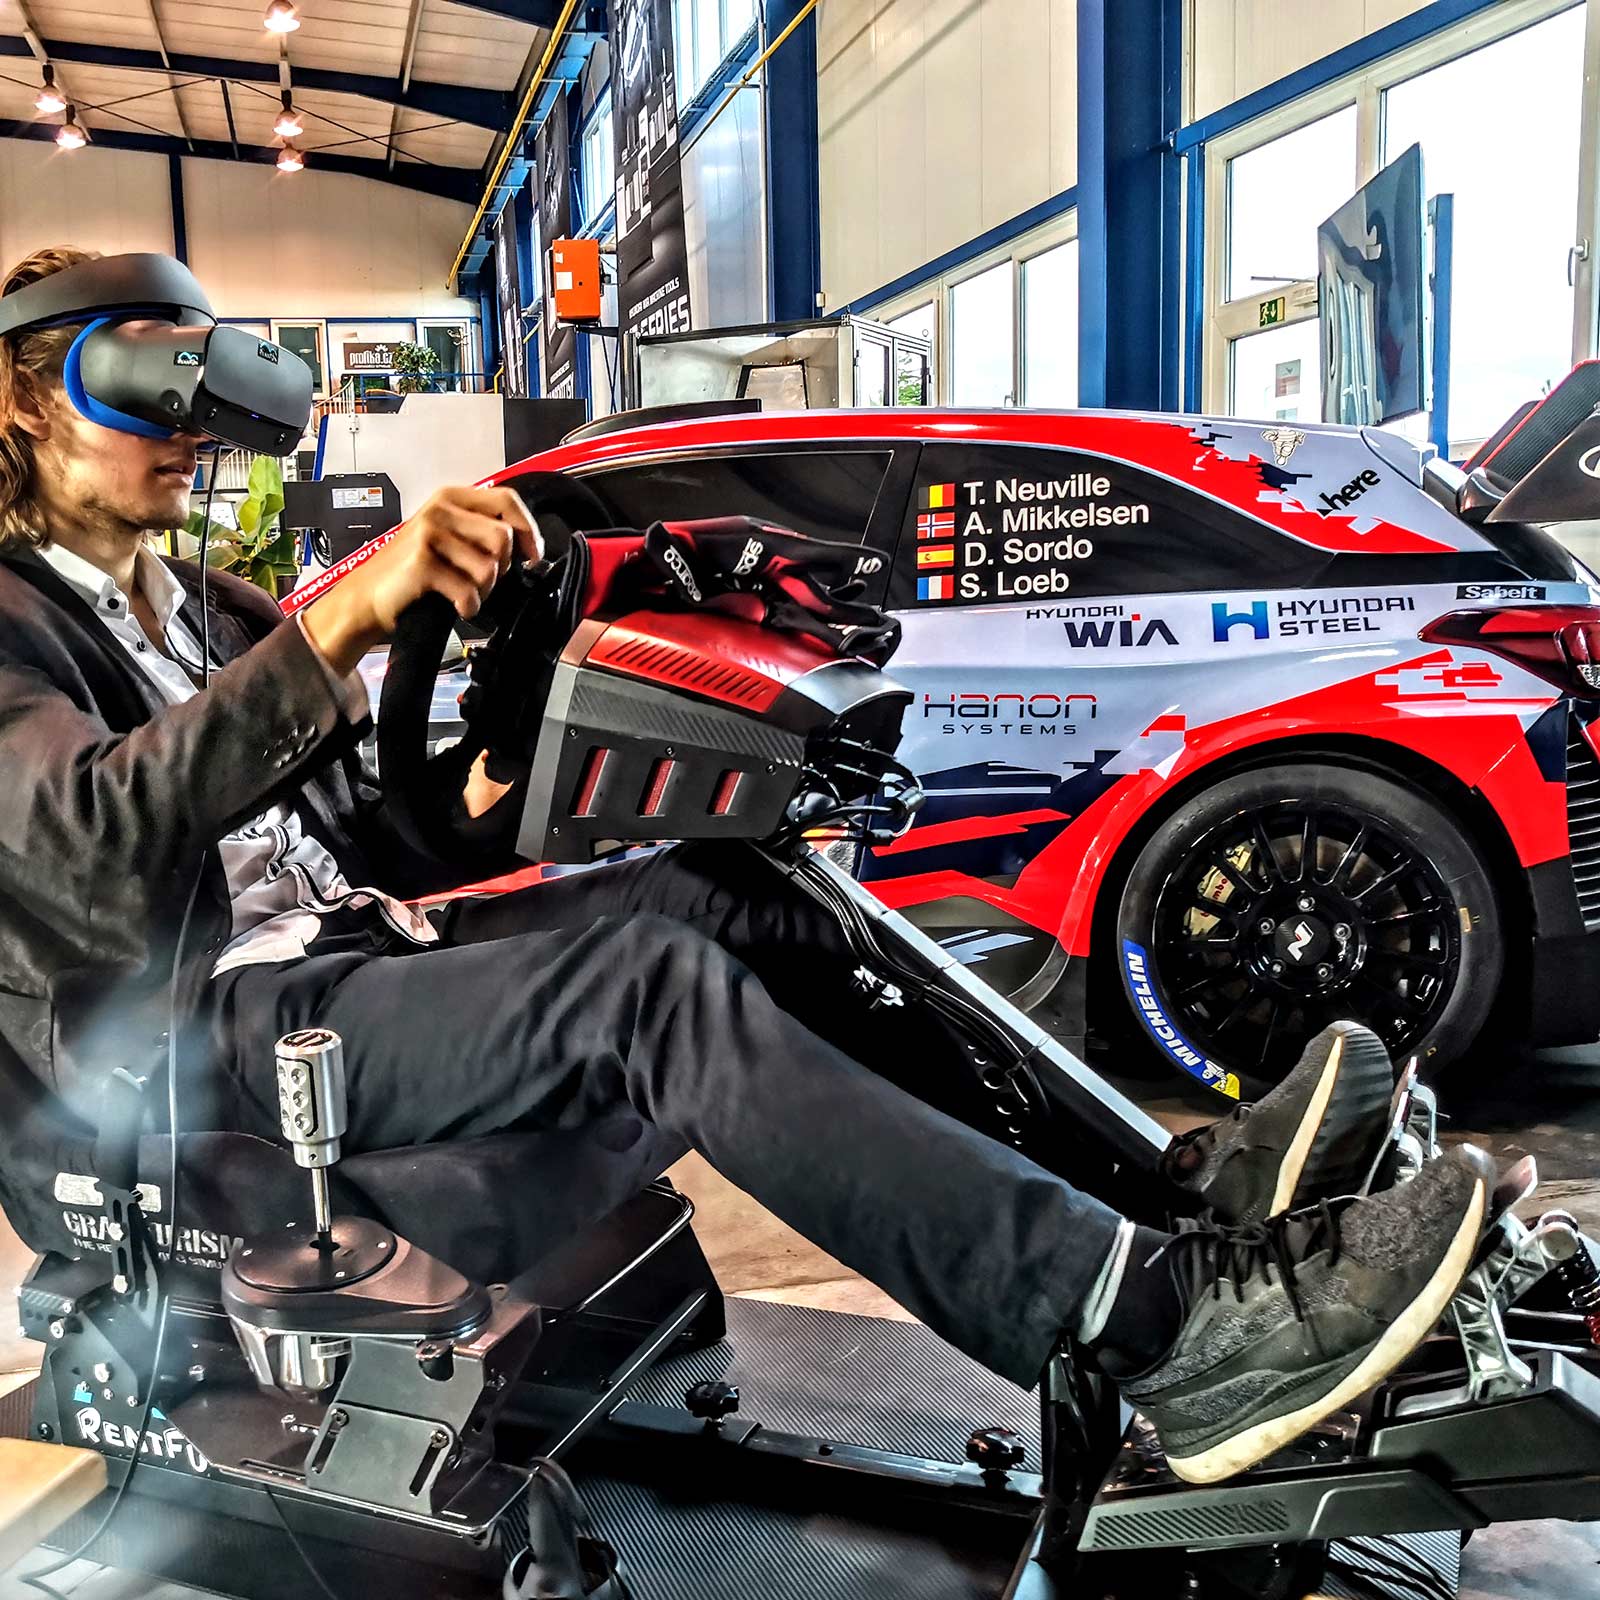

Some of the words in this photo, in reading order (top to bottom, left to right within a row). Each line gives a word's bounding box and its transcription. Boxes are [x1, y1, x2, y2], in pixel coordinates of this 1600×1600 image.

[963, 481, 986, 506] T.
[995, 473, 1111, 504] Neuville
[1319, 469, 1381, 511] here
[963, 511, 993, 537] A.
[1002, 502, 1150, 534] Mikkelsen
[964, 542, 994, 567] D.
[1003, 534, 1093, 564] Sordo
[291, 530, 399, 606] motorsport.h
[960, 573, 987, 599] S.
[997, 568, 1070, 597] Loeb
[1277, 597, 1415, 617] HYUNDAI
[1464, 585, 1539, 600] Sabelt
[1026, 605, 1124, 620] HYUNDAI
[1279, 617, 1381, 637] STEEL
[942, 724, 1076, 735] SYSTEMS
[1127, 951, 1202, 1067] MICHELIN
[75, 1407, 209, 1473] RENTFU
